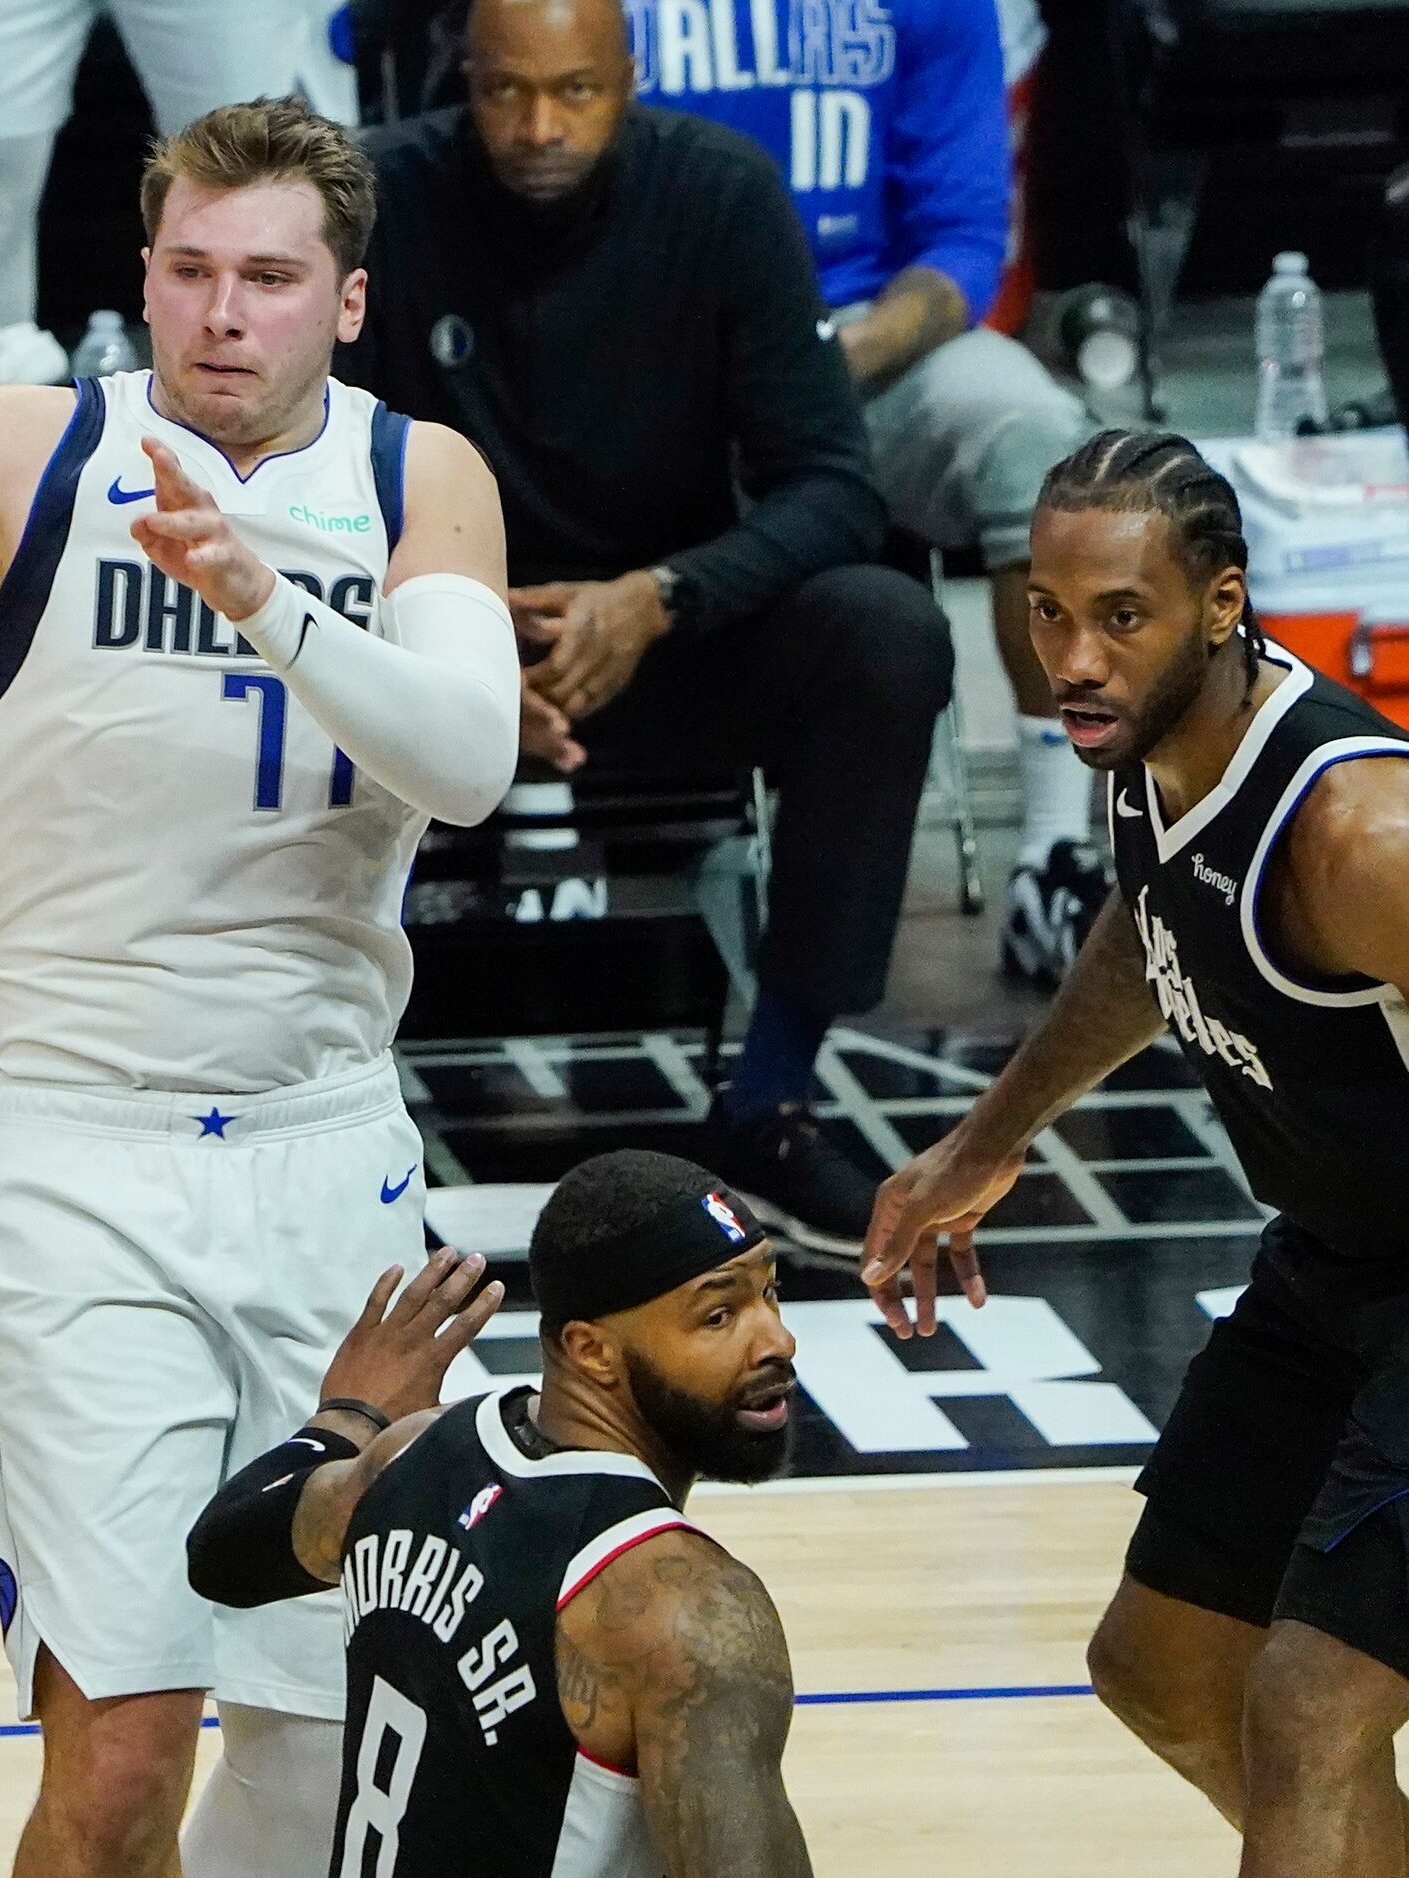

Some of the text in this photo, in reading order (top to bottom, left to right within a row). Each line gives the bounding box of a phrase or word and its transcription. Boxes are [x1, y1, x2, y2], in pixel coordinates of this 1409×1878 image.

[790, 88, 871, 192] IN
[289, 504, 372, 534] chime
[1192, 852, 1238, 906] honey
[457, 1617, 538, 1747] SR.
[339, 1674, 428, 1878] 8
